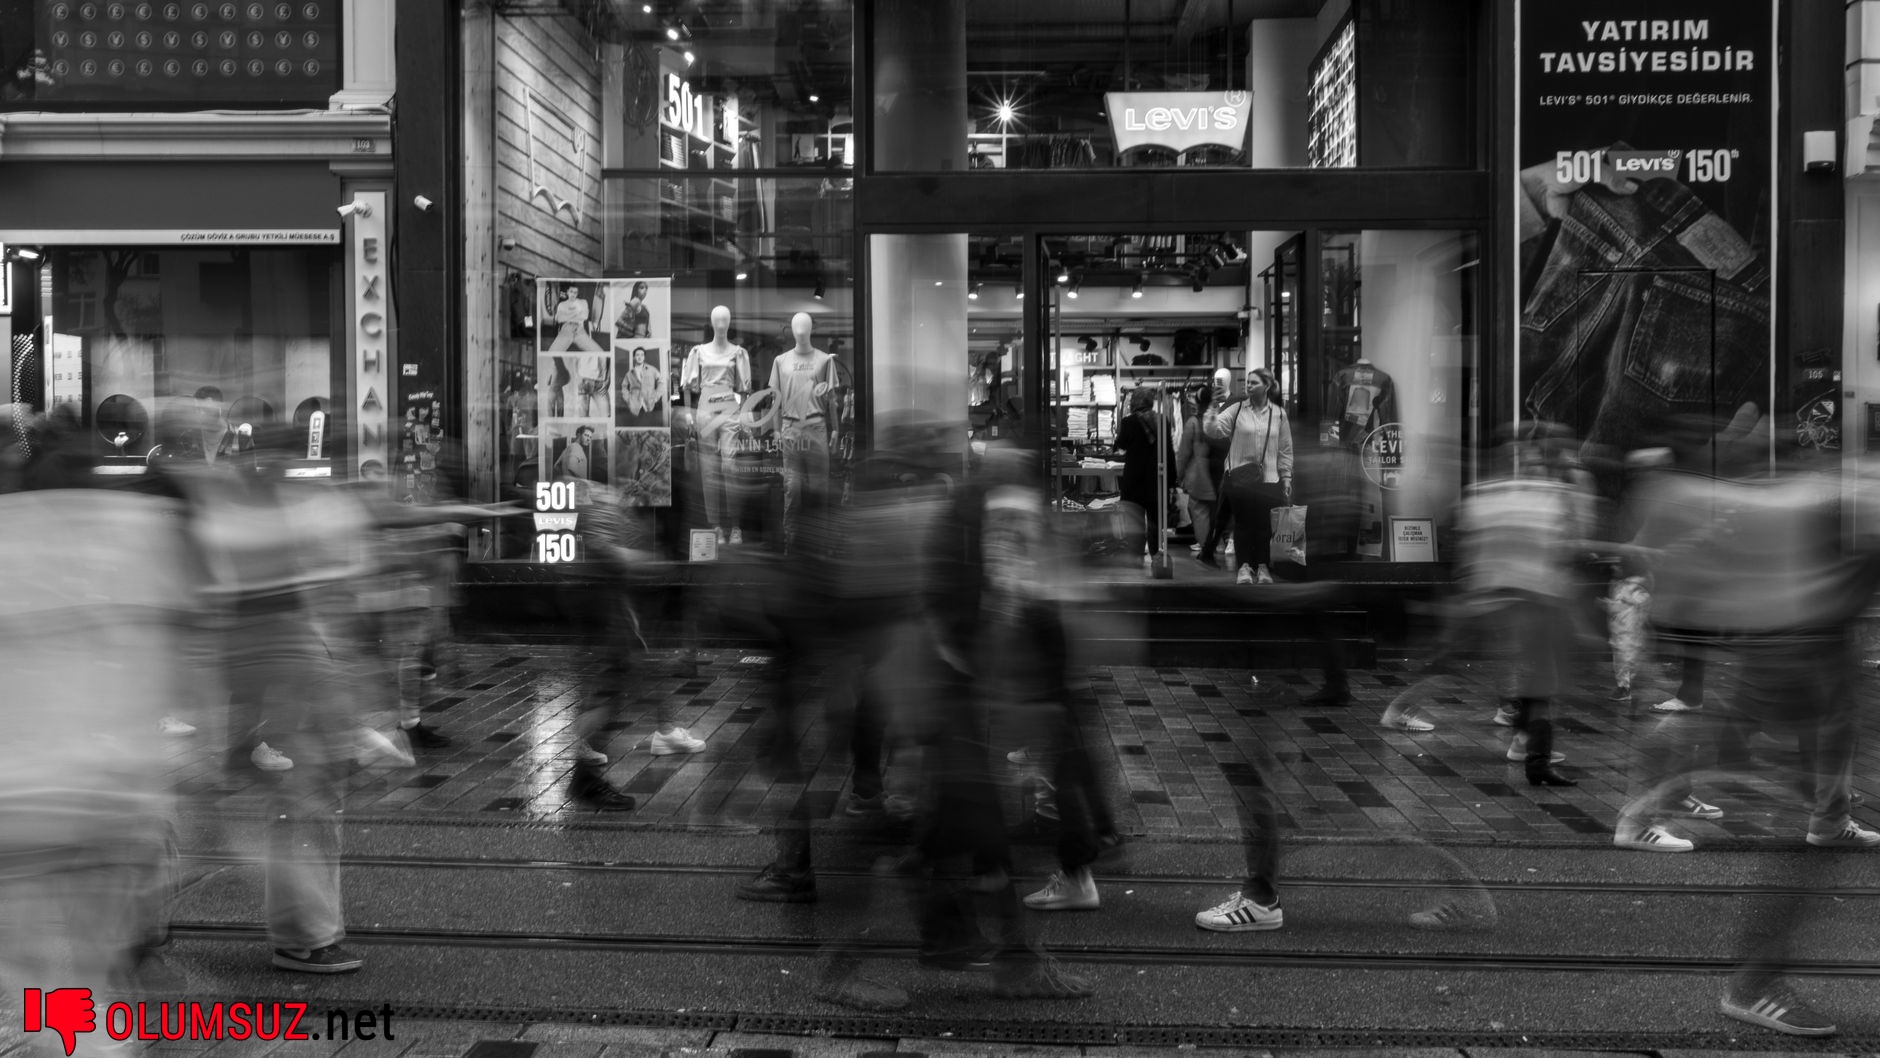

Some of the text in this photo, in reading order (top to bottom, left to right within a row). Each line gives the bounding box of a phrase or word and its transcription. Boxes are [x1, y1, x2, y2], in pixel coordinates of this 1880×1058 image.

[1582, 20, 1709, 41] YATIRIM
[1539, 46, 1754, 73] TAVSİYESİDİR
[669, 73, 702, 140] 501
[1368, 456, 1397, 466] TAILOR
[536, 482, 575, 511] 501
